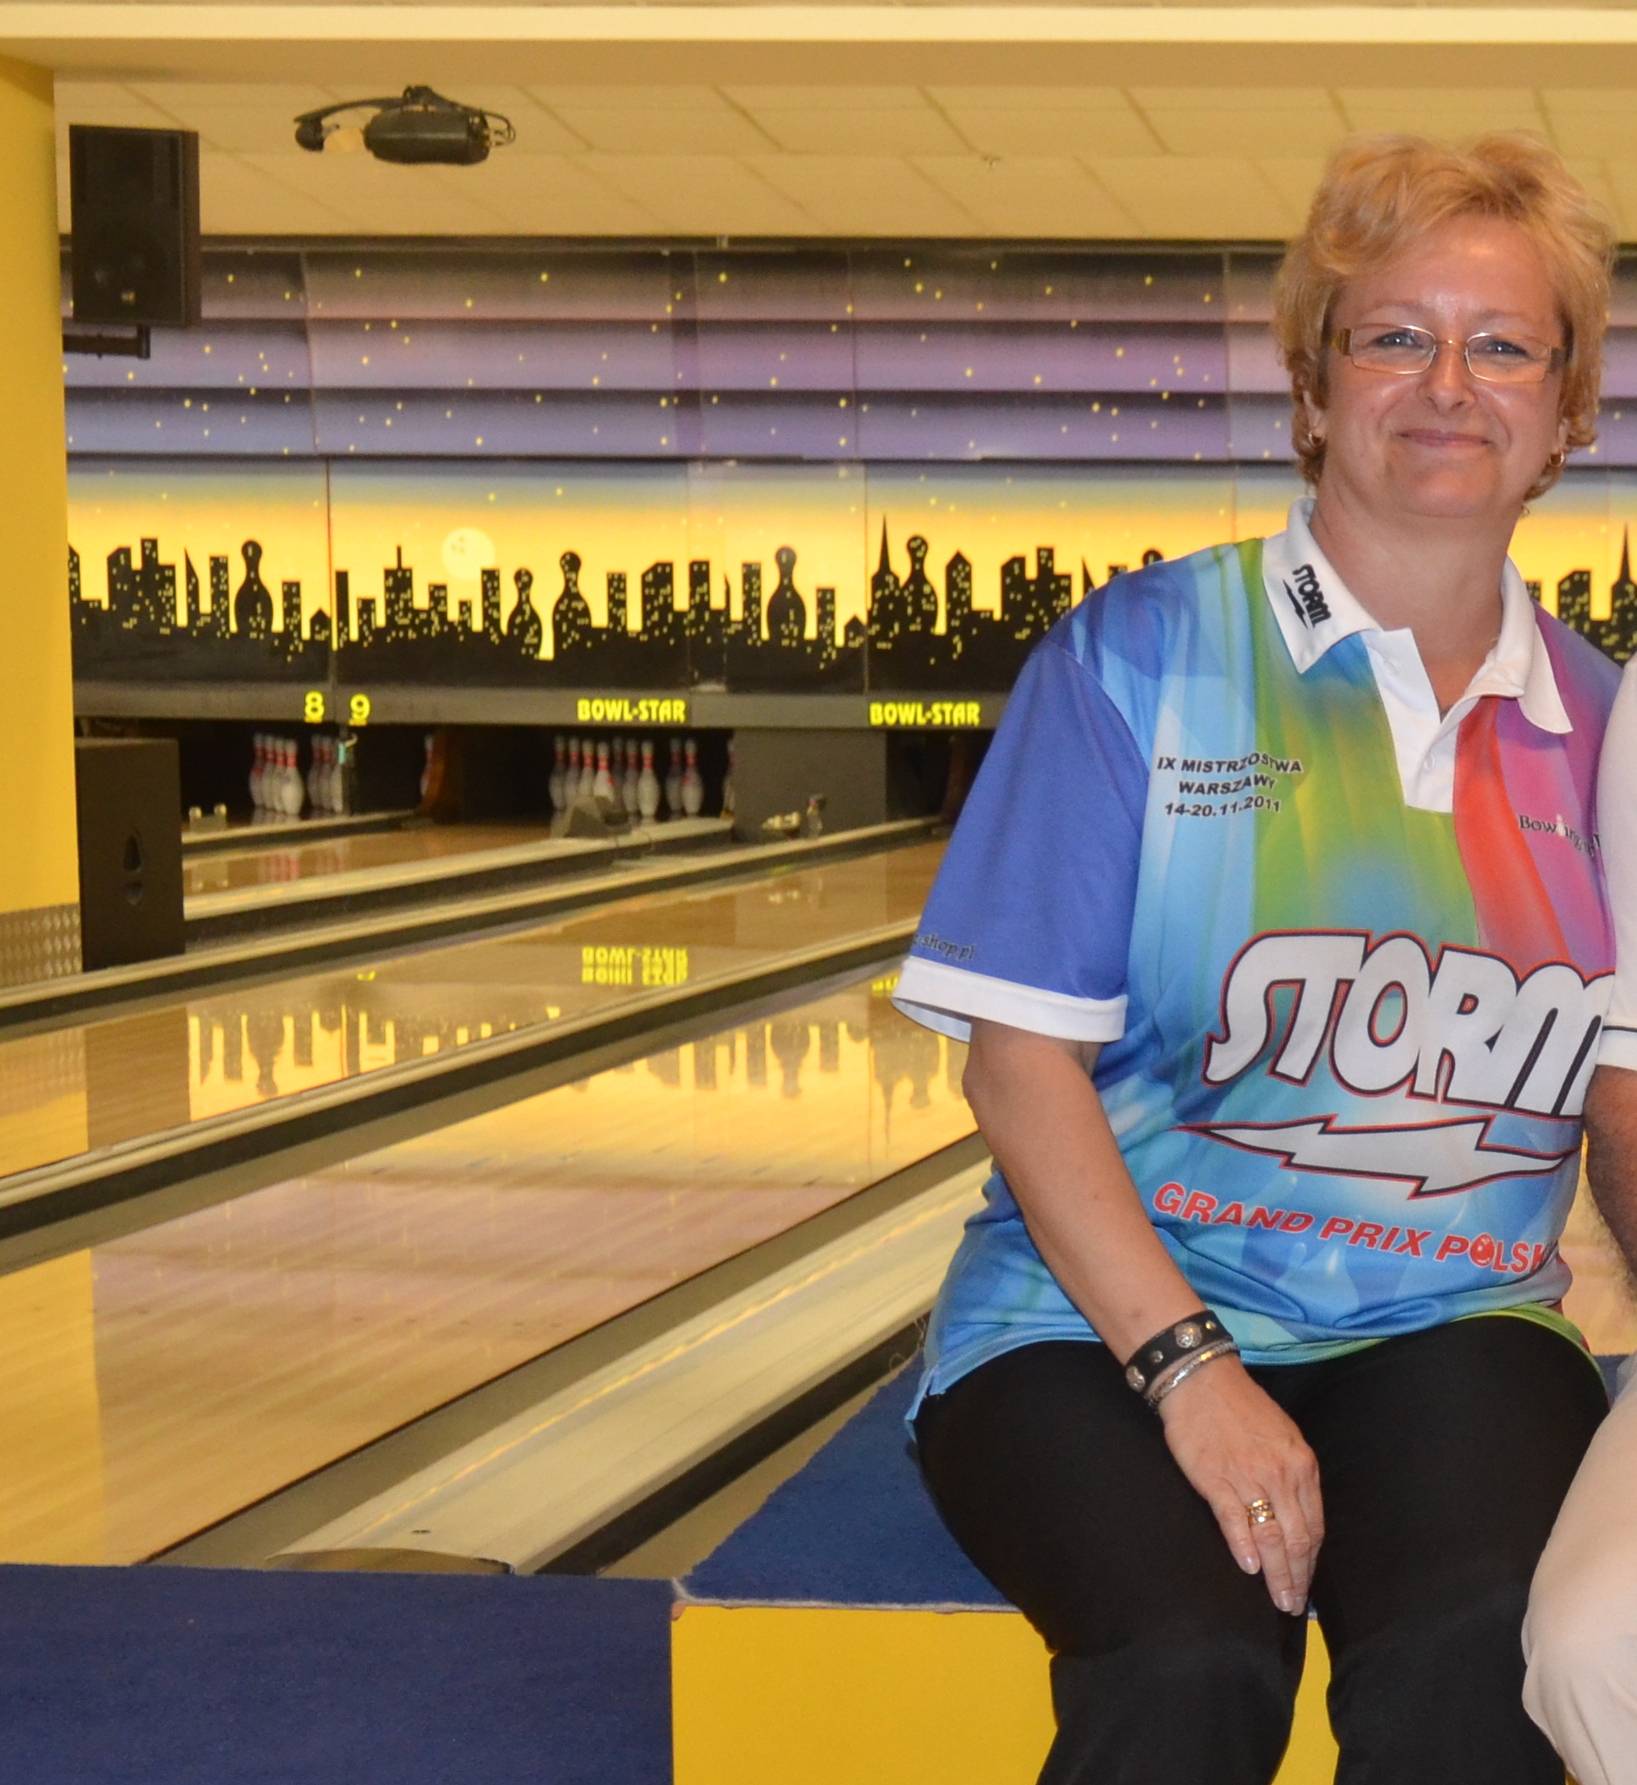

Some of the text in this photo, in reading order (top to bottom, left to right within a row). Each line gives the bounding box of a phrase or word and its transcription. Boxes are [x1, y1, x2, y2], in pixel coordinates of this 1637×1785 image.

[1292, 564, 1332, 629] STORM
[304, 690, 324, 720] 8
[350, 693, 370, 722] 9
[577, 698, 686, 723] BOWL-STAR
[870, 702, 980, 727] BOWL-STAR
[1157, 752, 1303, 773] IX MISTRZOSTWA
[1179, 774, 1277, 795] WARSZAWY
[1165, 795, 1281, 817] 14-20.11.2011
[1203, 929, 1616, 1117] STORM
[1153, 1182, 1313, 1233] GRAND
[1318, 1216, 1433, 1257] PRIX
